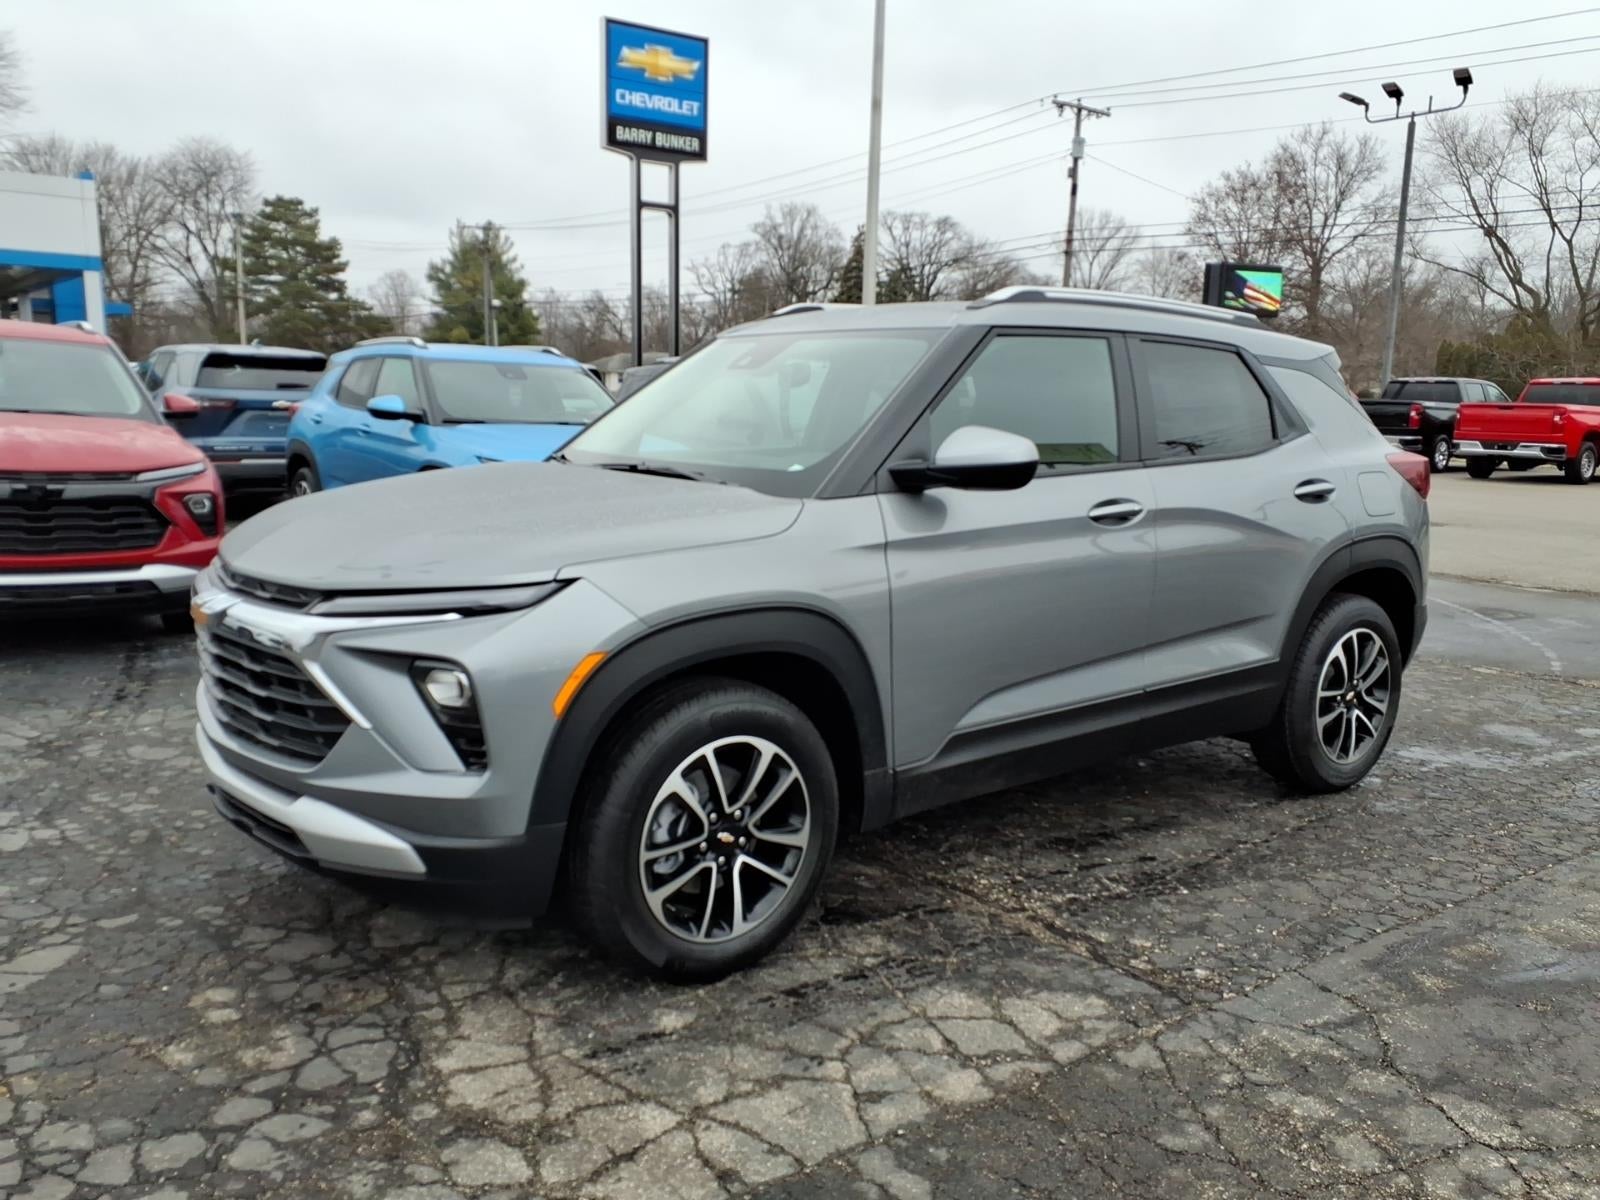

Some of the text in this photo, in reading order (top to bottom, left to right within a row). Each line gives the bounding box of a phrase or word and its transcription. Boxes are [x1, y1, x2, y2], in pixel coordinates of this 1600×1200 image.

[615, 88, 700, 116] CHEVROLET
[615, 125, 700, 152] BARRY BUNKER
